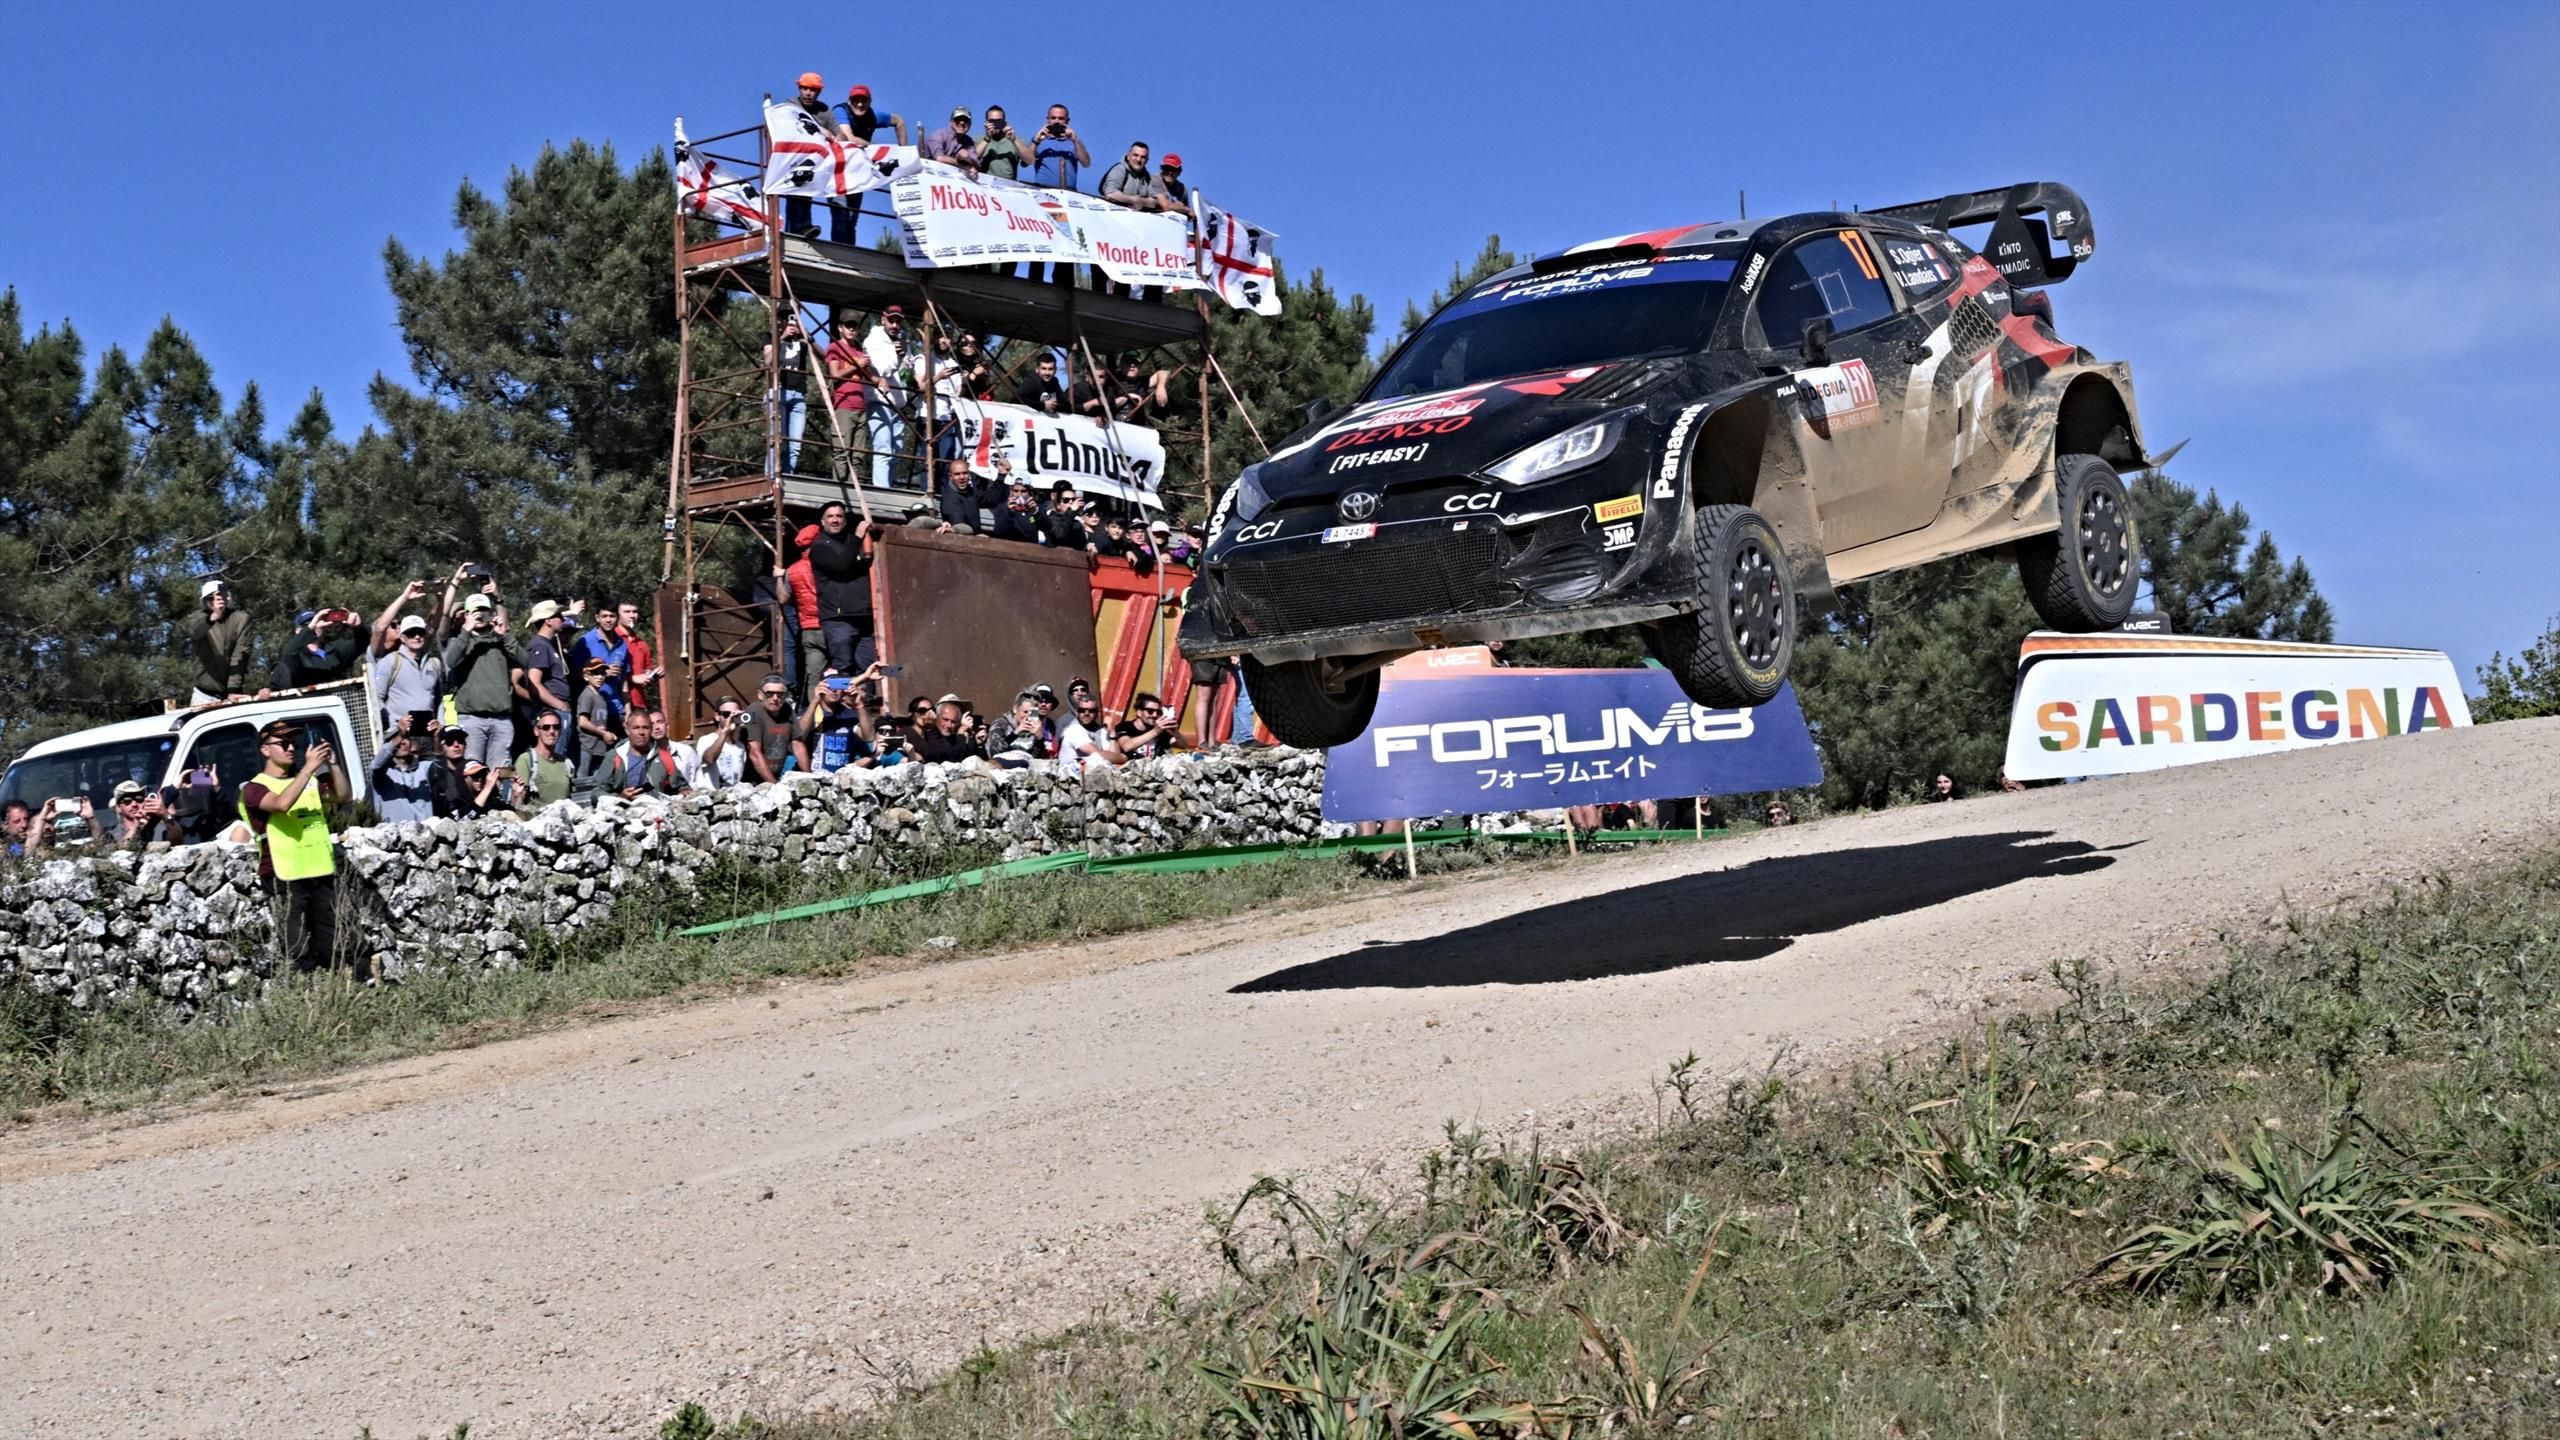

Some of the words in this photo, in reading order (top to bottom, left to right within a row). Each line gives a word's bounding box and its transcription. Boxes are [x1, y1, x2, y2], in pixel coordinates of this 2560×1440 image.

[1006, 210, 1055, 240] Jump
[1096, 241, 1149, 266] Monte
[1888, 247, 1924, 267] S.Ogier
[1995, 258, 2031, 275] TAMADIC
[1501, 267, 1654, 301] FORUM8
[1510, 269, 1578, 288] TOYOTA
[1579, 259, 1647, 274] GAZOO
[1649, 254, 1714, 264] Racing
[1894, 266, 1938, 288] V.Landais
[1776, 384, 1797, 398] PIAA
[1842, 364, 1874, 404] HY
[1326, 415, 1473, 451] DENSO
[1024, 418, 1153, 491] ichnusa
[1600, 499, 1640, 518] PIRELLI
[2123, 620, 2161, 631] WRC
[1428, 652, 1480, 668] WRC
[1373, 700, 1755, 768] FORUM8
[2036, 686, 2454, 752] SARDEGNA
[1476, 753, 1658, 790] フォーラムエイト
